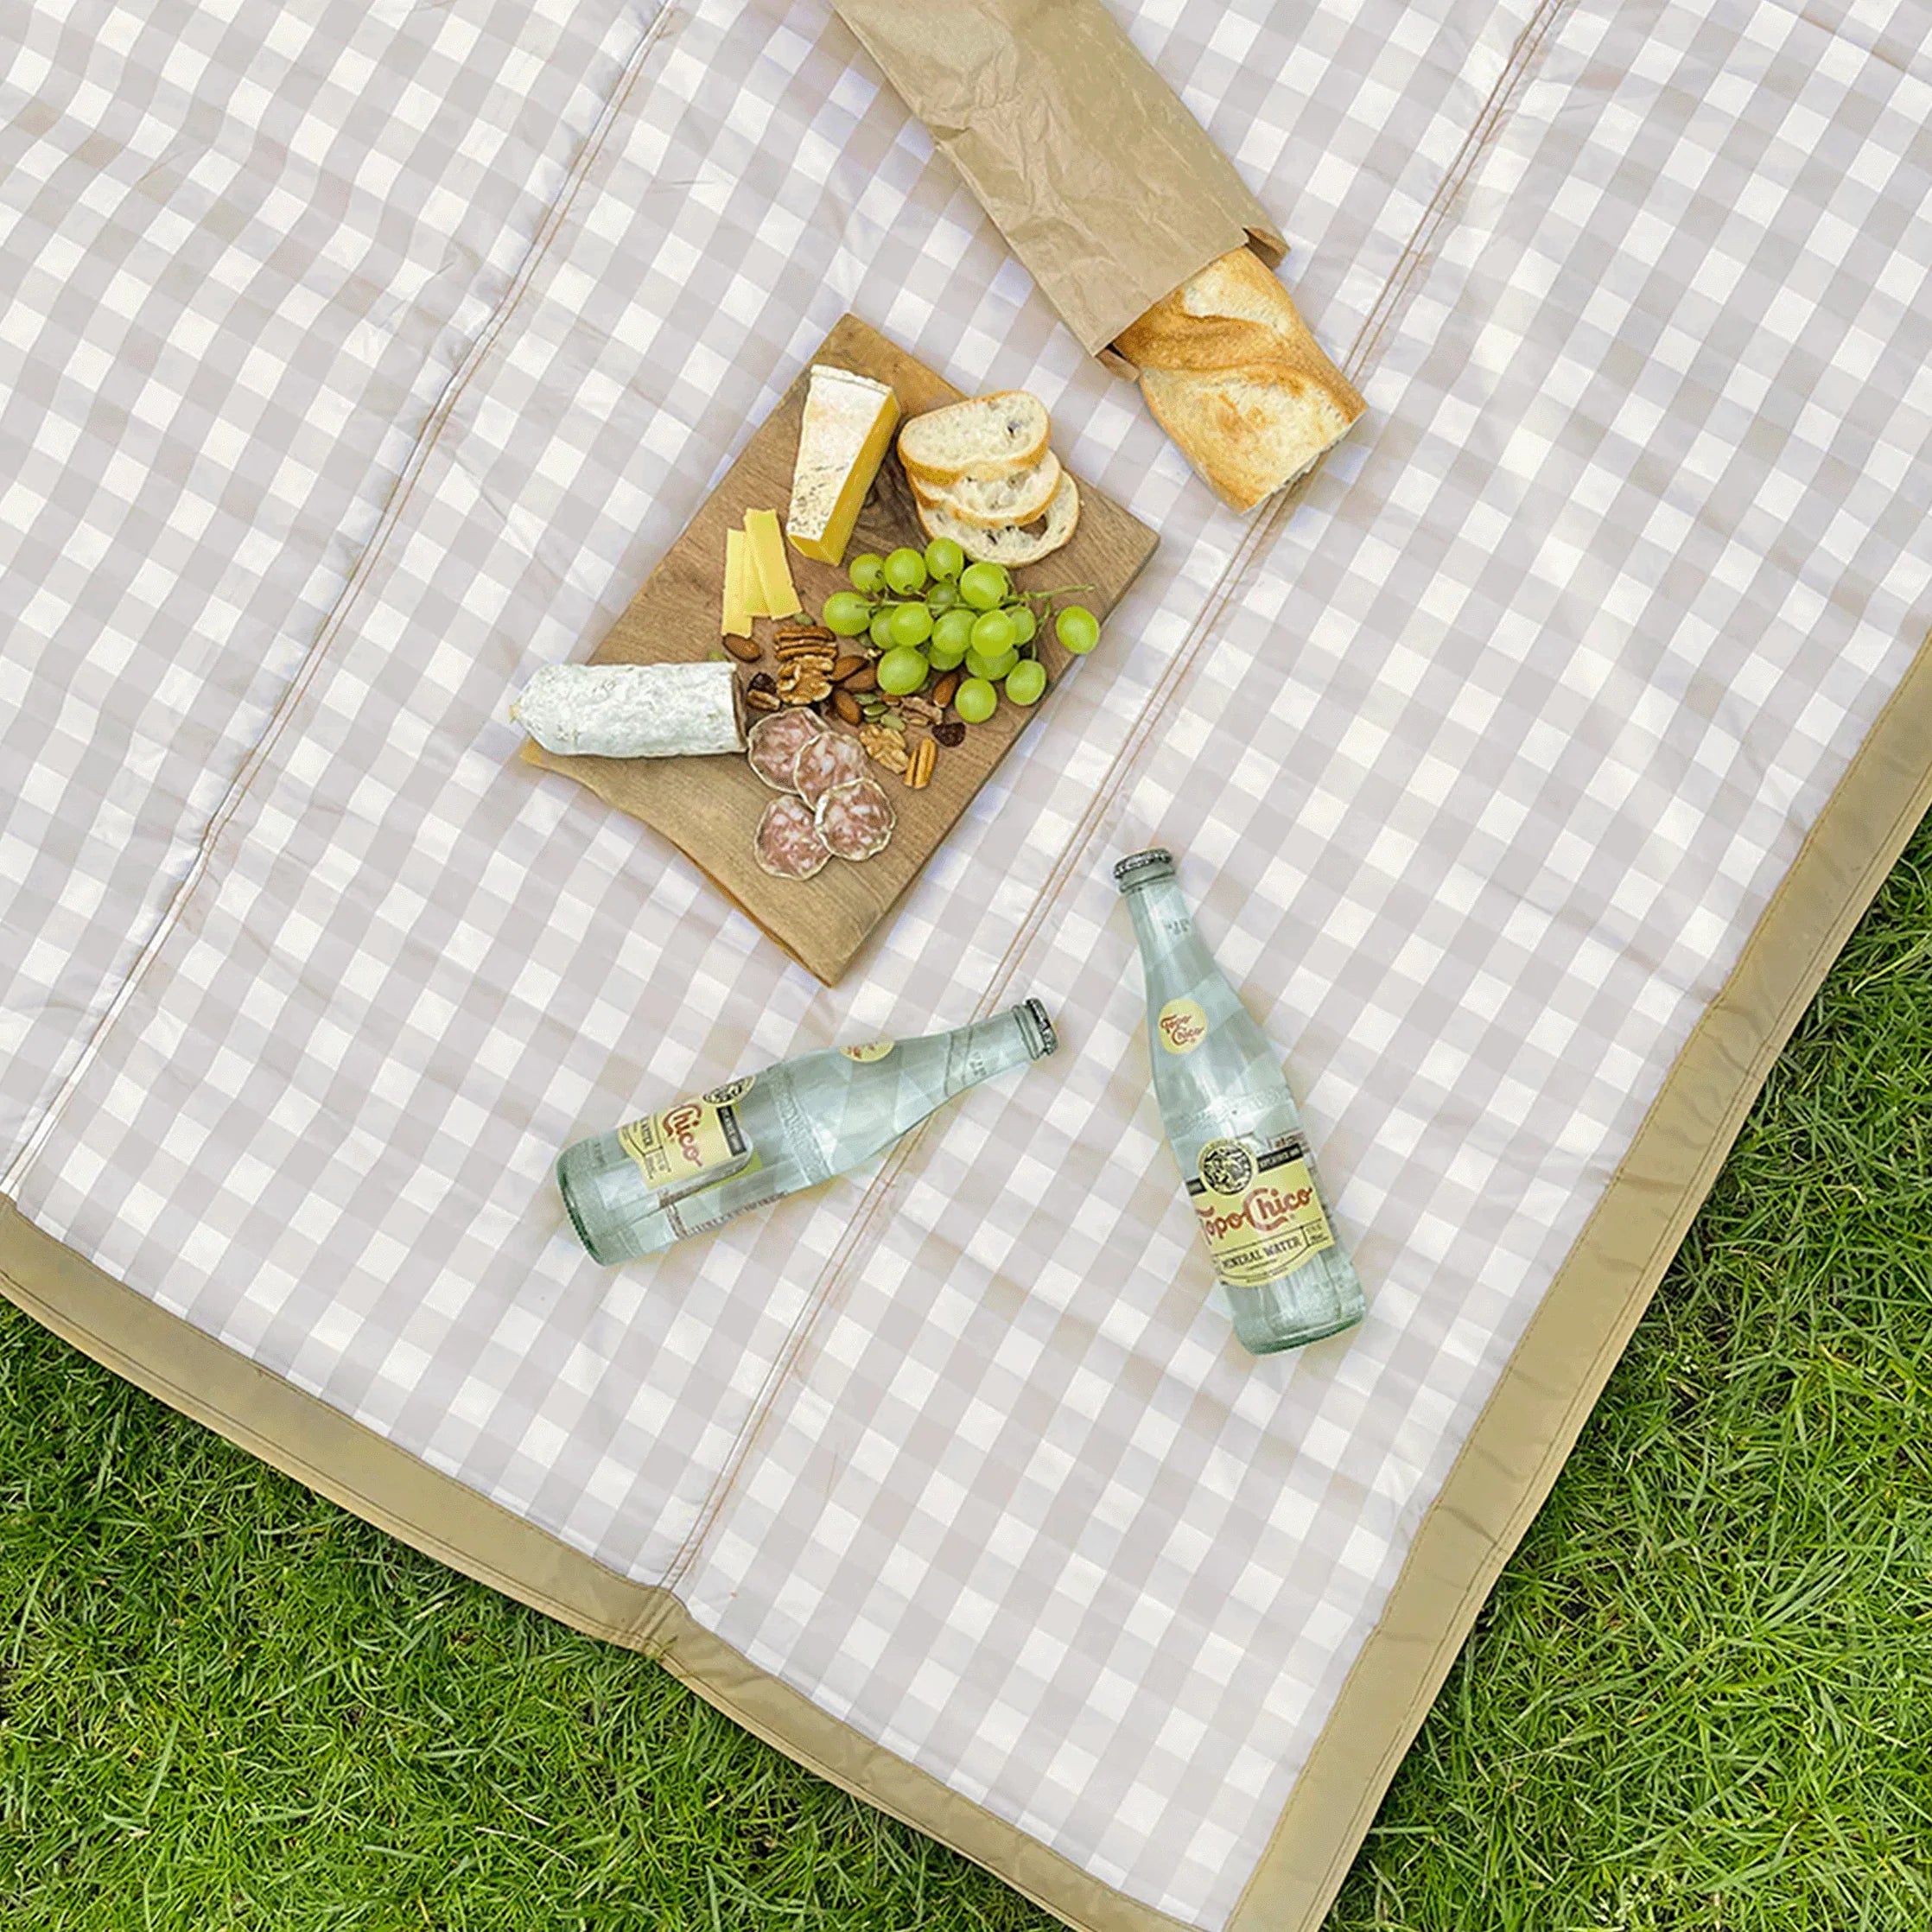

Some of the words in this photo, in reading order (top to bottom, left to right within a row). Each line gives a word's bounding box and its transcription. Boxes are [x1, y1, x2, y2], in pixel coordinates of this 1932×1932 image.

[1160, 1014, 1192, 1034] Topo
[1172, 1026, 1204, 1045] Chico
[664, 1103, 703, 1167] Chico
[1242, 1187, 1312, 1231] Chico
[1263, 1236, 1304, 1257] WATER
